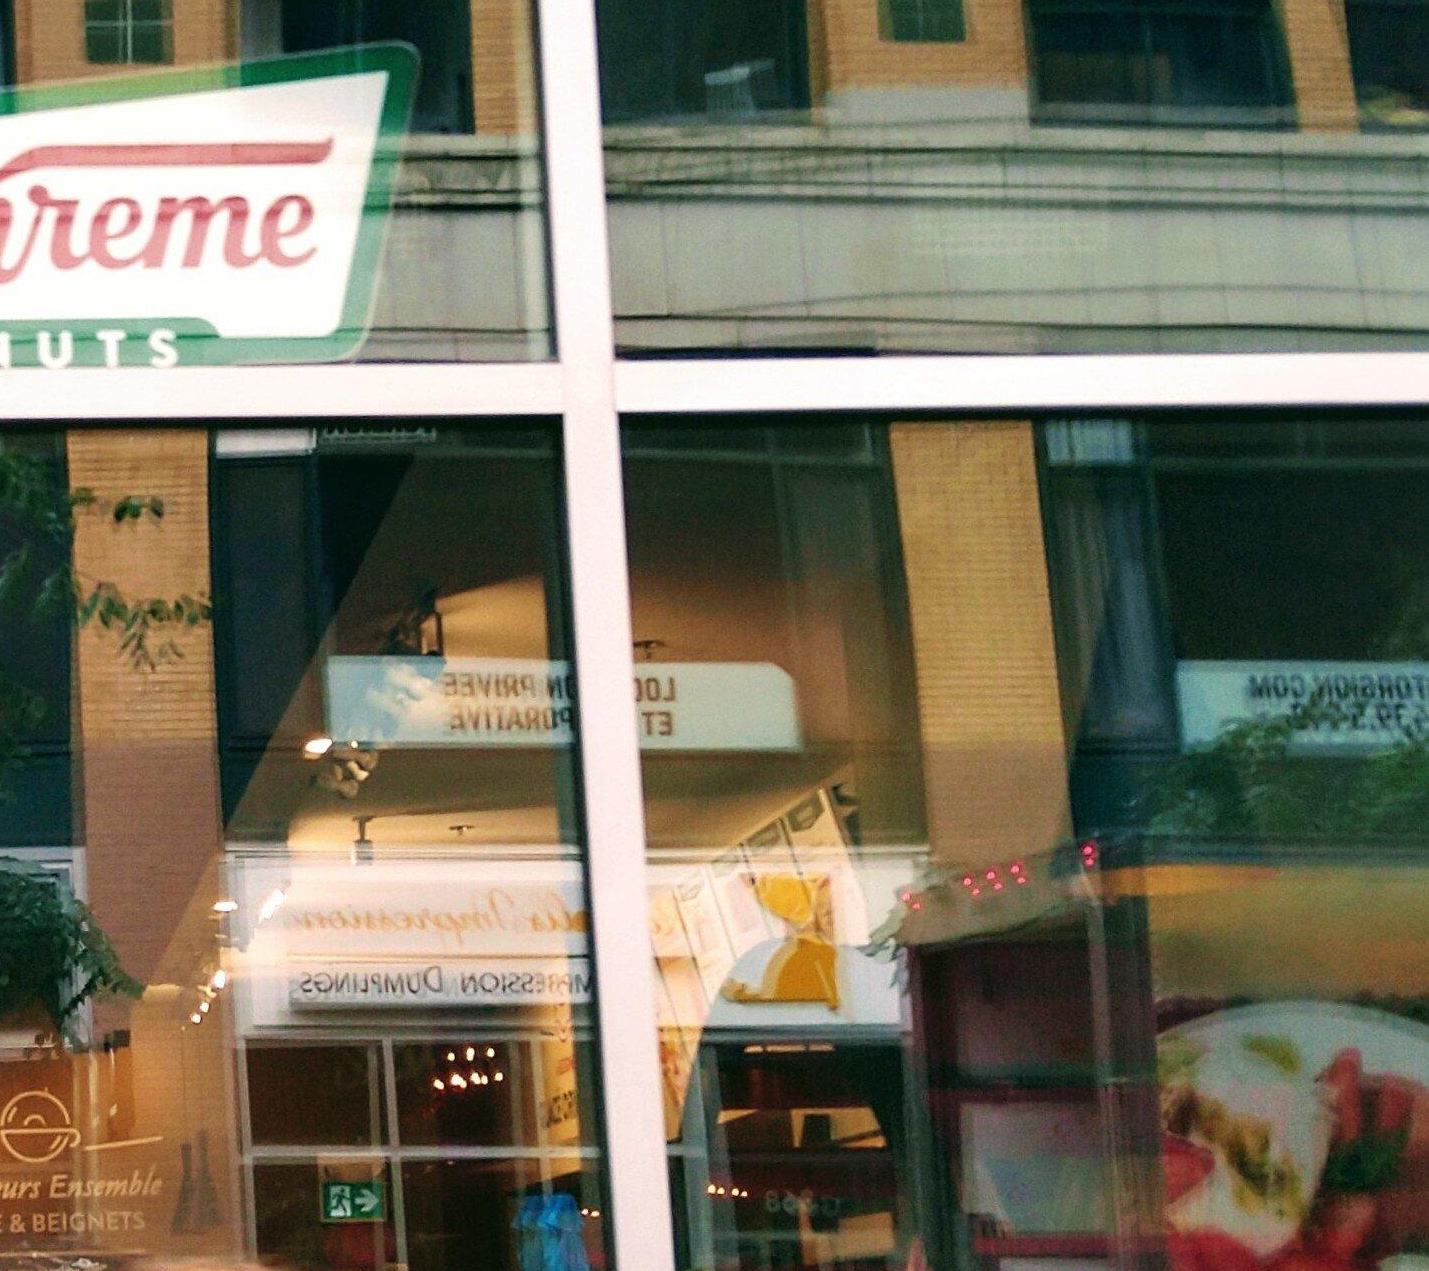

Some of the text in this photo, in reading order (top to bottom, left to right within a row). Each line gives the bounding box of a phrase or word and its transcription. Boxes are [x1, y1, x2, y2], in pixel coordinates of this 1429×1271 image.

[48, 1163, 163, 1197] Ensemble
[9, 1213, 26, 1234] &
[32, 1210, 145, 1233] BEIGNETS
